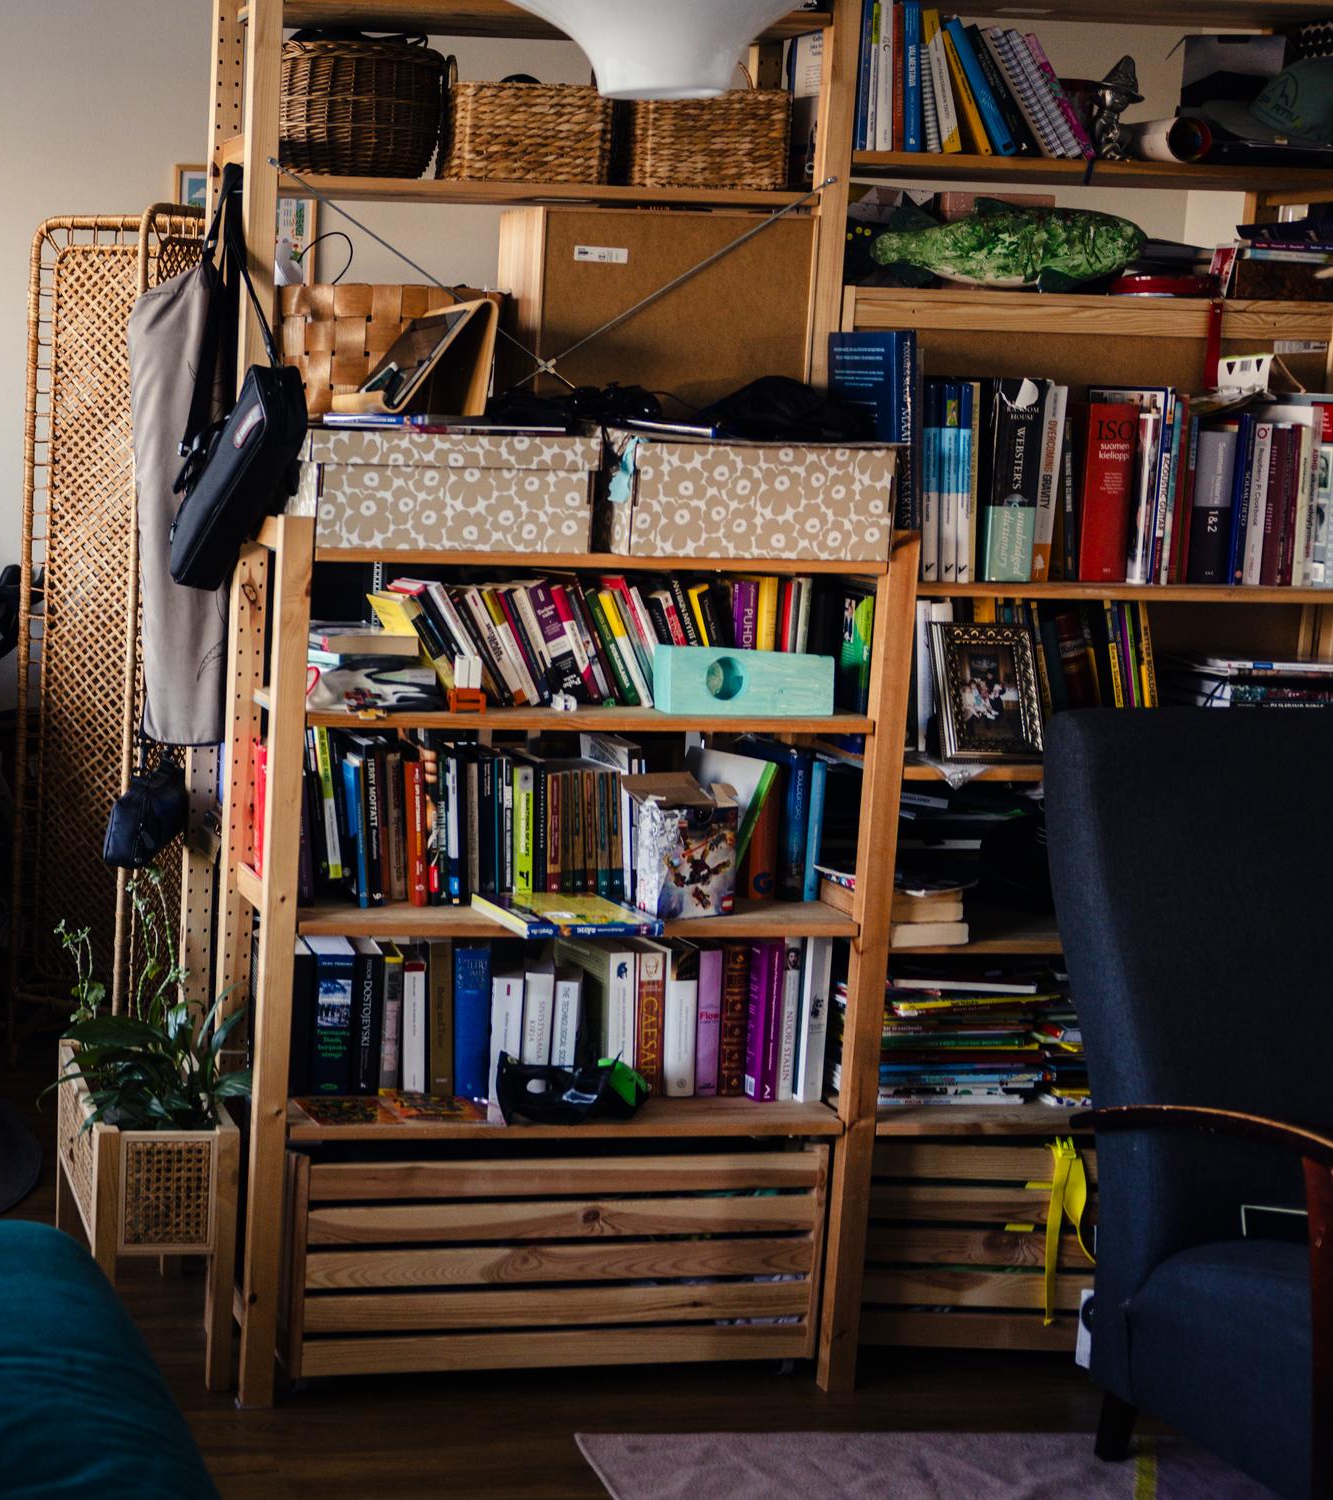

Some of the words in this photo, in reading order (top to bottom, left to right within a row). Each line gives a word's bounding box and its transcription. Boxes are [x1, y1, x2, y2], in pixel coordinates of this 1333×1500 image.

[1044, 419, 1058, 472] OVERCOMING
[1097, 419, 1137, 441] ISO
[1012, 426, 1027, 491] WEBSTER'S
[1098, 450, 1130, 462] kielioppi
[1253, 447, 1265, 482] Raspberry
[1039, 474, 1052, 510] GRAVITY
[1158, 455, 1170, 498] ACOUSTIC
[1156, 500, 1167, 532] GUITAR
[1206, 510, 1219, 533] 1&2
[1252, 492, 1263, 526] Cookbook
[1000, 510, 1014, 569] dictionary
[1011, 511, 1028, 578] unabridged
[1143, 625, 1152, 658] BETTER
[367, 758, 377, 785] JERRY
[369, 786, 378, 828] MOFFATT
[360, 980, 373, 1046] DOSTOJEVSKI
[699, 1011, 720, 1020] Flow
[784, 1010, 794, 1045] NUORI
[640, 996, 659, 1076] CAESAR
[782, 1047, 791, 1081] STALIN
